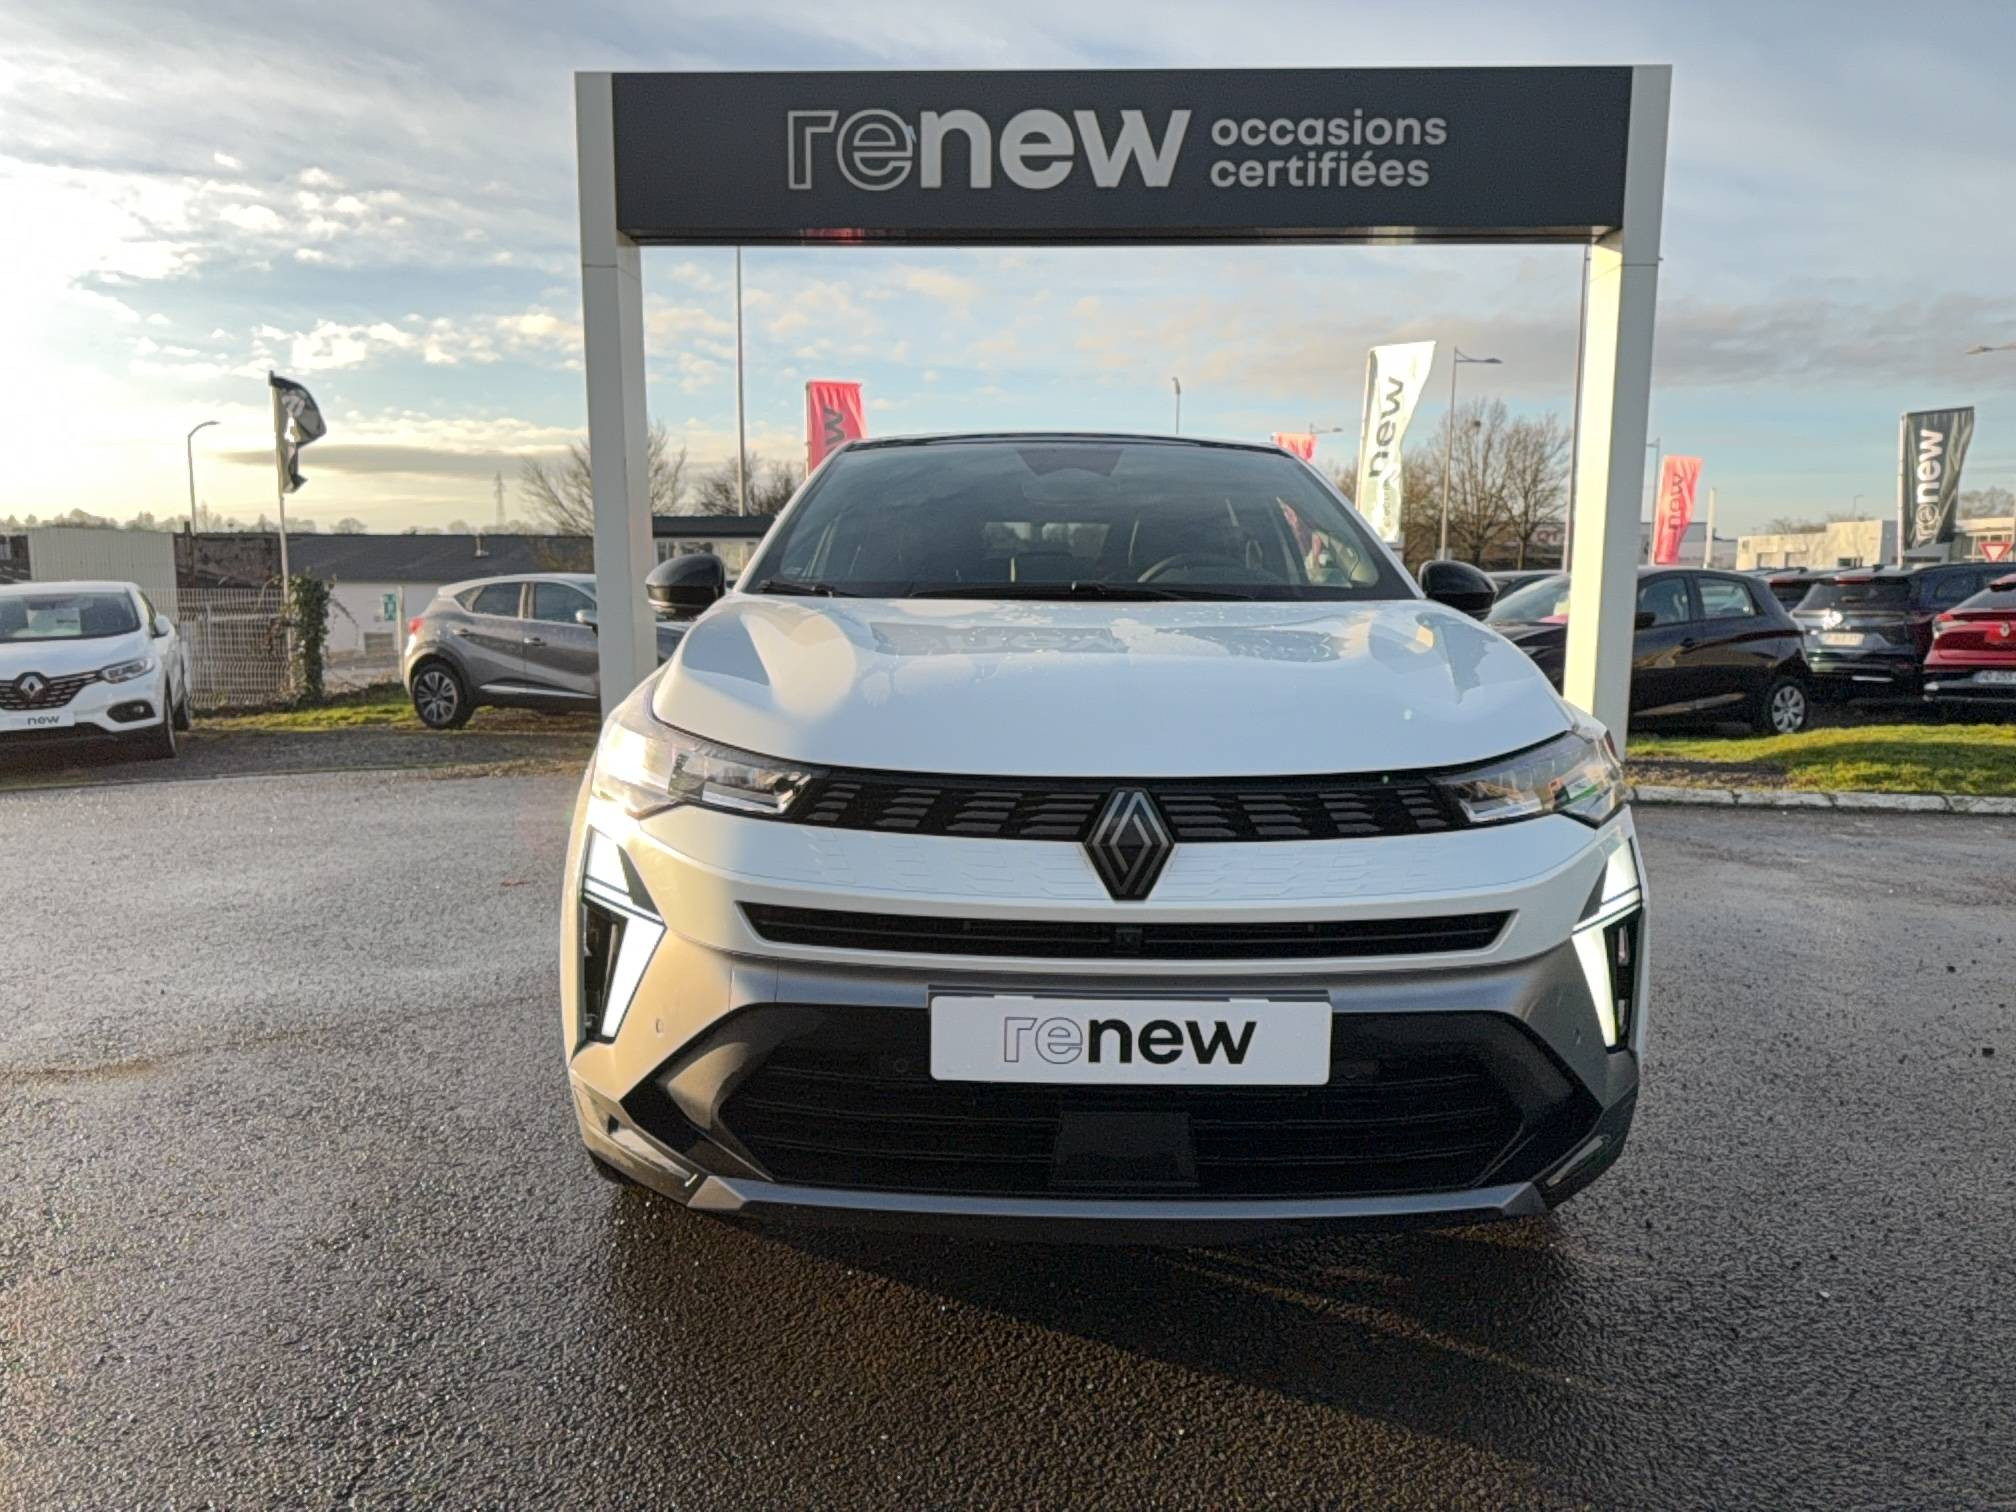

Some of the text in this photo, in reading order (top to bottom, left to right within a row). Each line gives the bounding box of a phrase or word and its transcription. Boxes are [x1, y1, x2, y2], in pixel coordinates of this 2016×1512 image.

[1211, 108, 1448, 146] occasions
[787, 108, 1193, 191] renew
[1210, 151, 1430, 188] certifiées
[1004, 1016, 1257, 1065] renew
